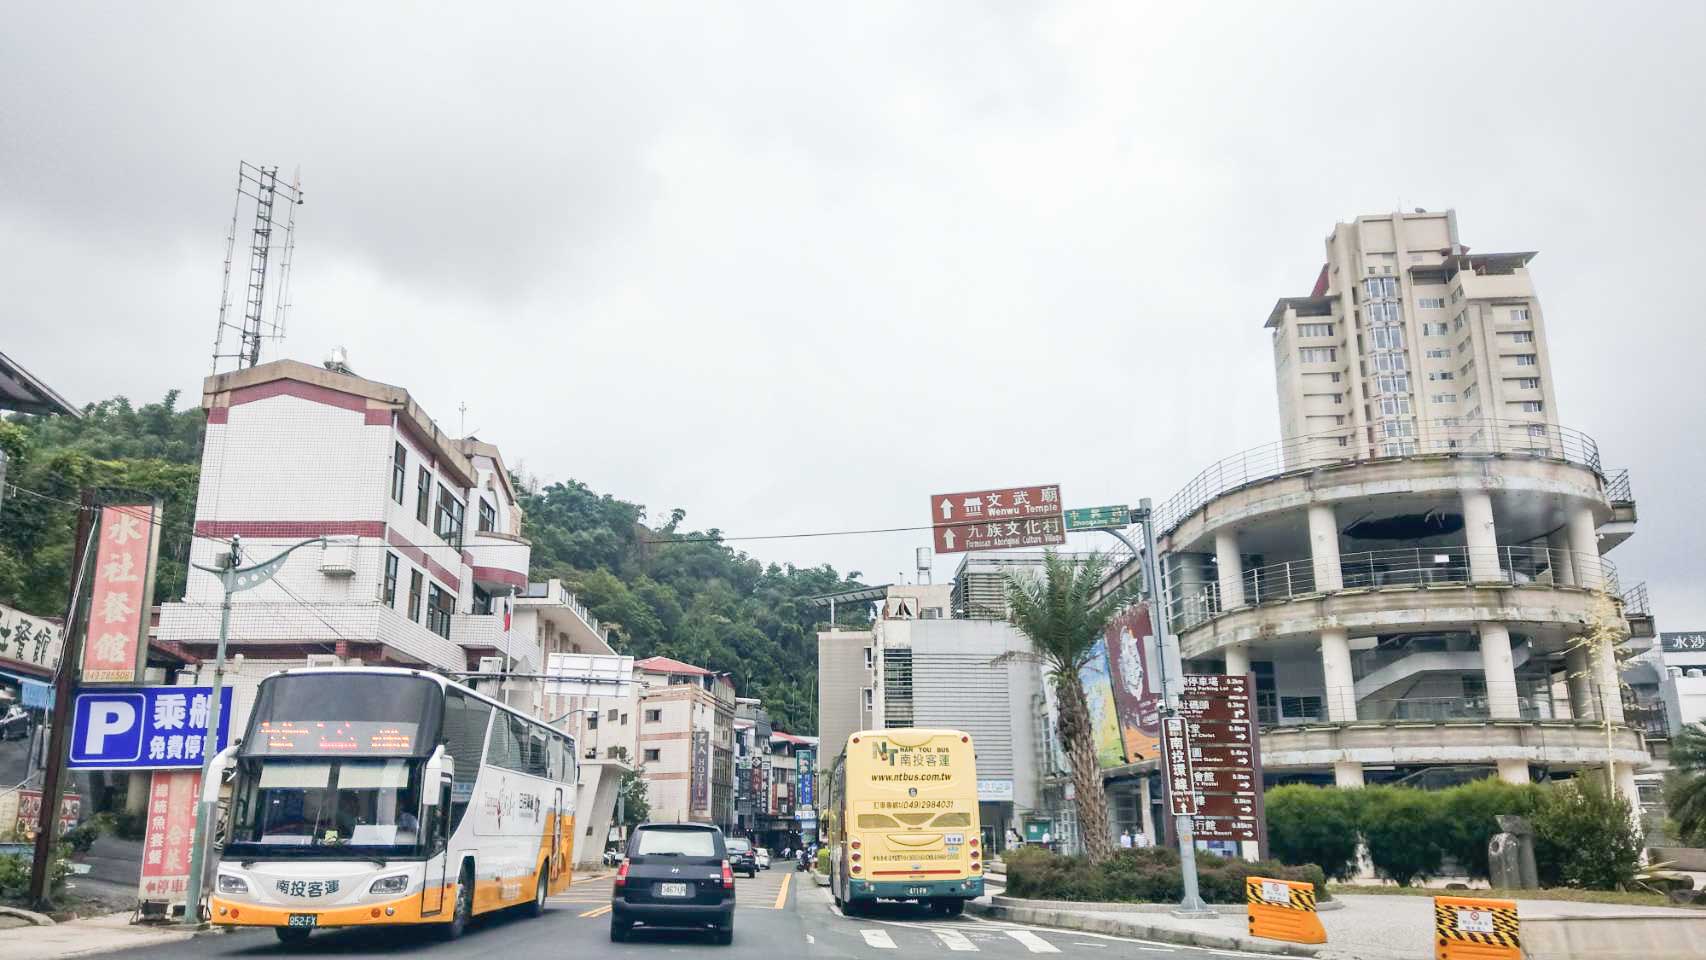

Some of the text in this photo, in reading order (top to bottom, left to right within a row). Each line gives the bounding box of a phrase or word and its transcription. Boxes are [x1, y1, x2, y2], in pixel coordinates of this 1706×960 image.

[986, 486, 1057, 507] 文武廟
[988, 504, 1057, 516] Wenwu Temple
[968, 518, 1059, 538] 九族文化村
[93, 512, 144, 663] 水社餐館
[85, 702, 135, 755] P
[149, 735, 218, 760] 免費停
[872, 741, 898, 766] NT
[901, 754, 950, 766] 南投客運
[872, 773, 952, 782] www.ntbus.com.tw
[276, 880, 340, 898] 南投客運
